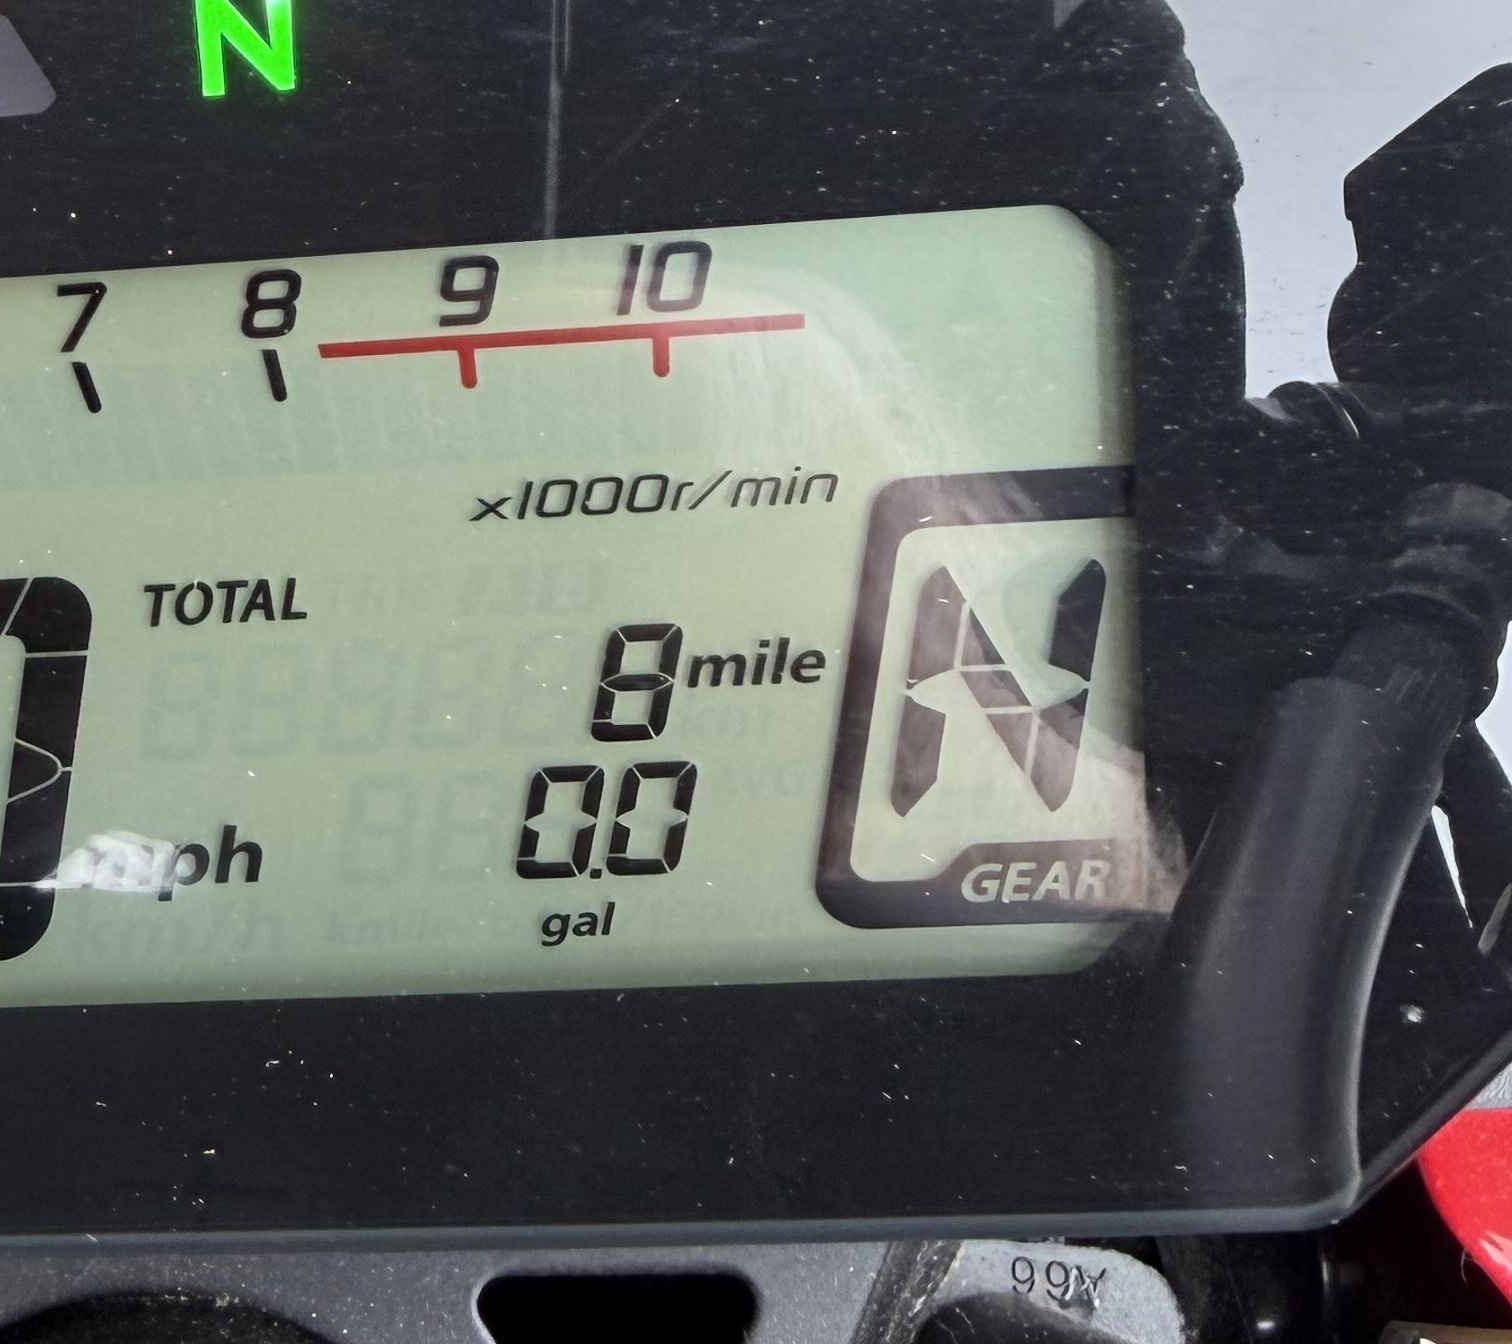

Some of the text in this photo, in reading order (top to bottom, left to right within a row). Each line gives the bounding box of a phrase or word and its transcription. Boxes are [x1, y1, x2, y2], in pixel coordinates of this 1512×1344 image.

[57, 280, 108, 354] 7
[240, 268, 303, 339] 8
[438, 255, 500, 328] 9
[616, 240, 713, 316] 10
[143, 577, 309, 627] TOTAL
[590, 623, 826, 742] 8 mile
[890, 559, 1107, 818] N
[516, 760, 698, 880] 0.0
[540, 901, 615, 947] gal
[961, 860, 1112, 905] GEAR
